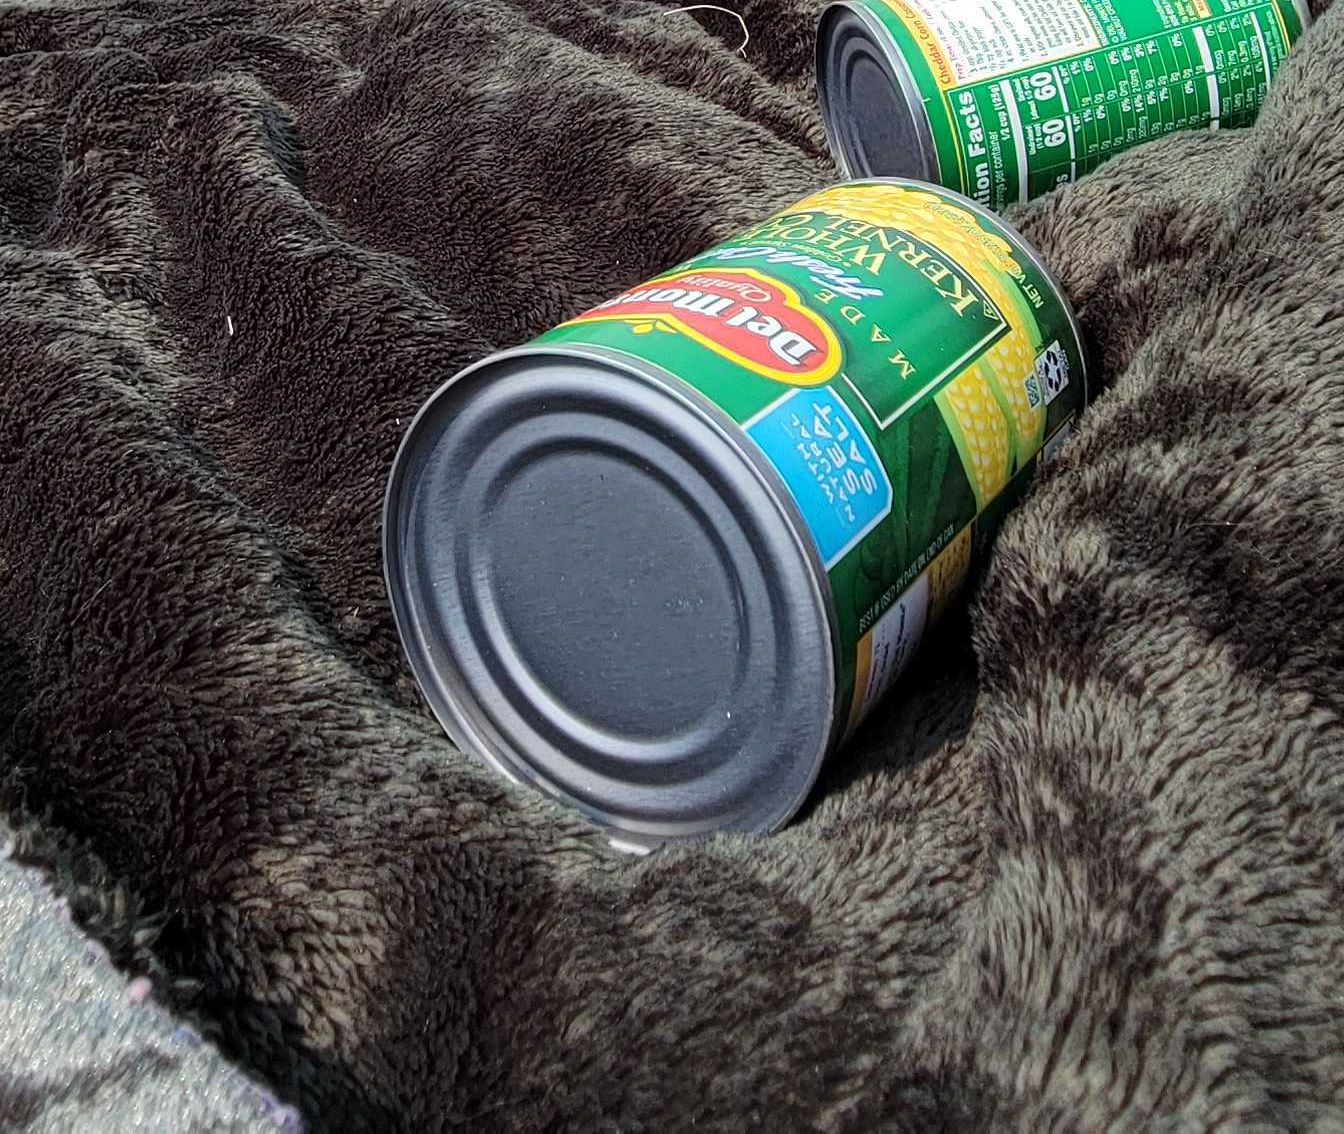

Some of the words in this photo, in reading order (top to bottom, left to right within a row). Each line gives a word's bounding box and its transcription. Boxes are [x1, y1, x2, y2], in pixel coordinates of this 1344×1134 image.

[909, 18, 930, 40] Corn
[1203, 23, 1215, 37] 0%
[1216, 20, 1227, 34] 0%
[1144, 39, 1157, 55] 7%
[1170, 33, 1182, 48] 0%
[921, 40, 952, 84] Cheddar
[1082, 56, 1094, 73] 0%
[1107, 49, 1120, 65] 0%
[1226, 49, 1237, 67] 7mg
[1068, 59, 1081, 76] 1%
[1180, 67, 1193, 80] 0g
[1229, 67, 1239, 81] 2%
[1241, 64, 1251, 77] 2%
[1253, 60, 1263, 73] 4%
[1216, 70, 1227, 84] 0%
[1030, 69, 1058, 104] 60
[1116, 79, 1130, 97] 0mg
[1157, 87, 1169, 102] 7%
[1182, 80, 1193, 95] 0%
[988, 83, 1005, 111] (125g)
[1080, 96, 1092, 108] 1g
[1093, 92, 1105, 105] 0g
[1120, 97, 1132, 113] 0%
[1132, 93, 1145, 114] 14%
[1145, 89, 1157, 106] 5%
[997, 109, 1010, 128] cup
[1082, 108, 1093, 123] 1%
[1094, 104, 1106, 120] 0%
[958, 90, 986, 157] Facts
[999, 127, 1010, 142] 1/2
[1041, 117, 1067, 150] 60
[986, 130, 1003, 170] container
[994, 169, 1005, 184] per
[824, 215, 980, 318] KERNEL
[675, 273, 773, 303] Quality
[1022, 281, 1044, 308] NET
[726, 305, 817, 366] Del
[813, 288, 917, 380] MADE
[812, 402, 878, 496] SALT
[813, 414, 861, 496] SEA
[791, 412, 856, 523] NATURAL
[797, 442, 834, 504] WITH
